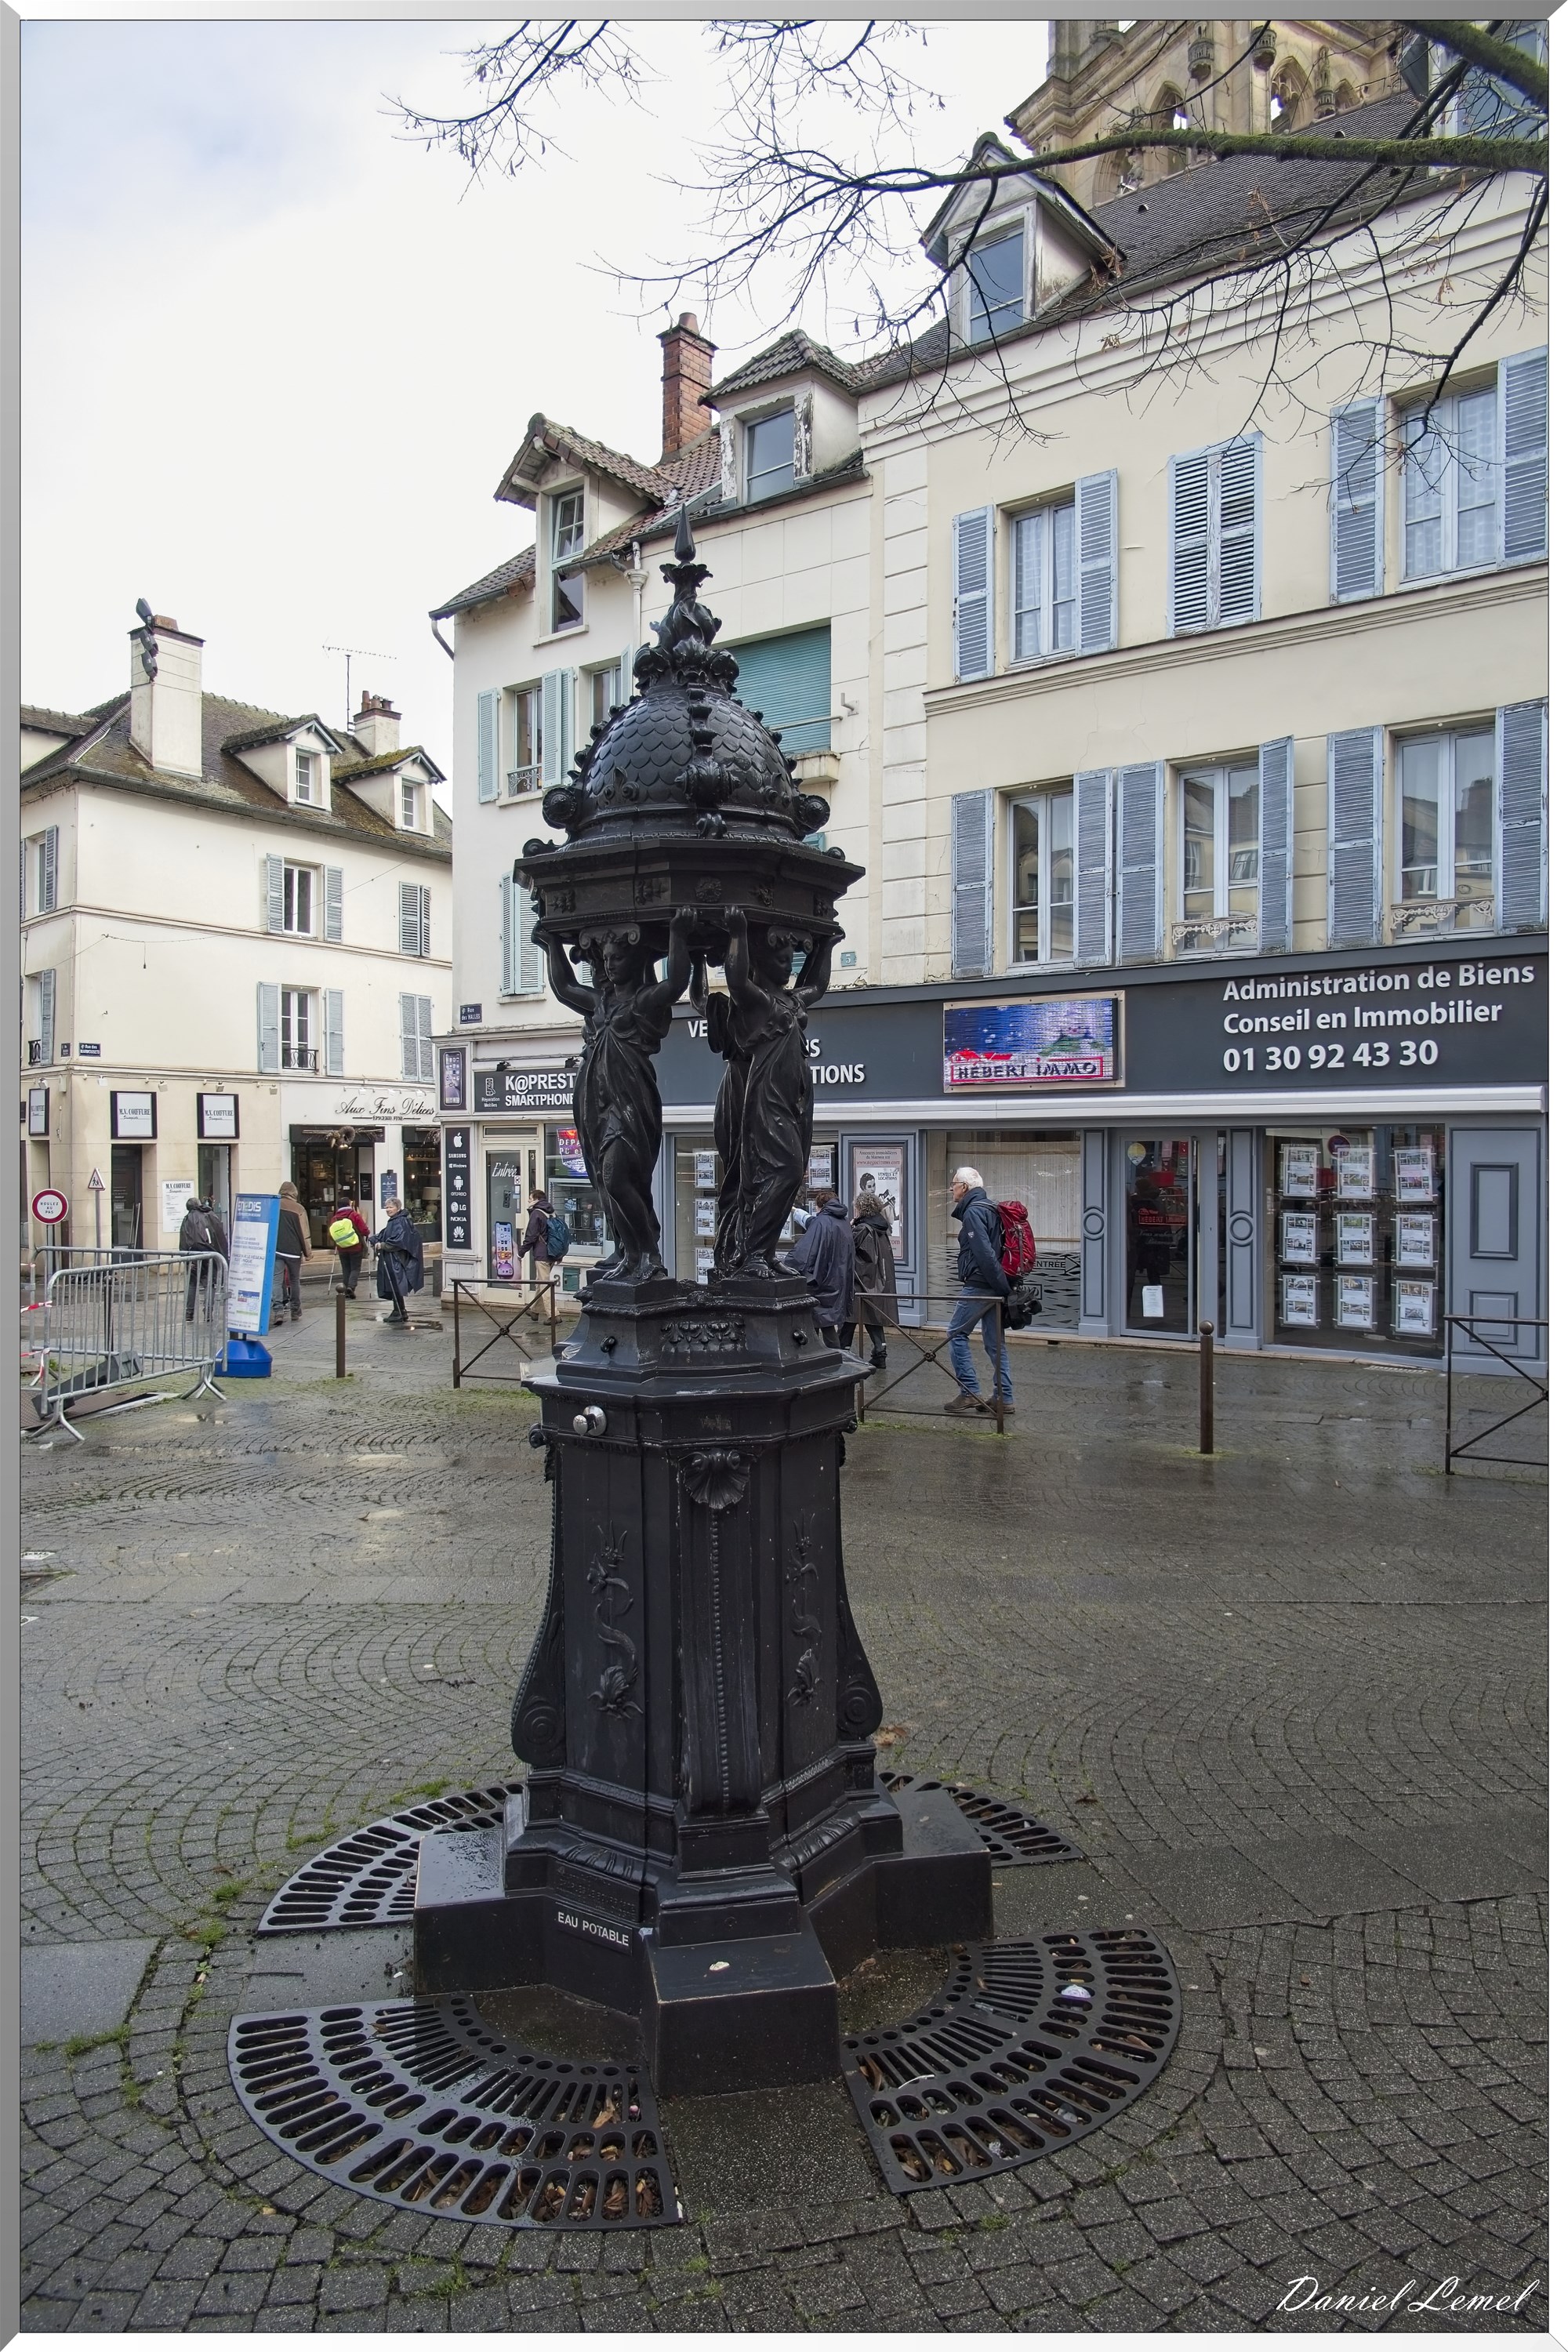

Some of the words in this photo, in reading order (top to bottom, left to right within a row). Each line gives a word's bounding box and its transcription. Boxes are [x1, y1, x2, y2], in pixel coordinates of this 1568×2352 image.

[1223, 970, 1410, 1001] Administration
[1417, 965, 1451, 989] de
[1458, 962, 1535, 986] Biens
[1223, 1008, 1310, 1034] Conseil
[1316, 1013, 1347, 1029] en
[1354, 1000, 1503, 1028] Immobilier
[1036, 1062, 1097, 1077] IMMO
[1222, 1047, 1254, 1072] 01
[1265, 1045, 1301, 1071] 30
[1308, 1044, 1345, 1069] 92
[1352, 1041, 1390, 1067] 43
[1399, 1040, 1439, 1065] 30
[335, 1096, 365, 1114] Aux
[369, 1097, 395, 1114] Fins
[400, 1098, 434, 1115] Délices
[492, 1161, 517, 1178] Entrée
[557, 1911, 579, 1928] EAU
[583, 1920, 629, 1946] POTABLE
